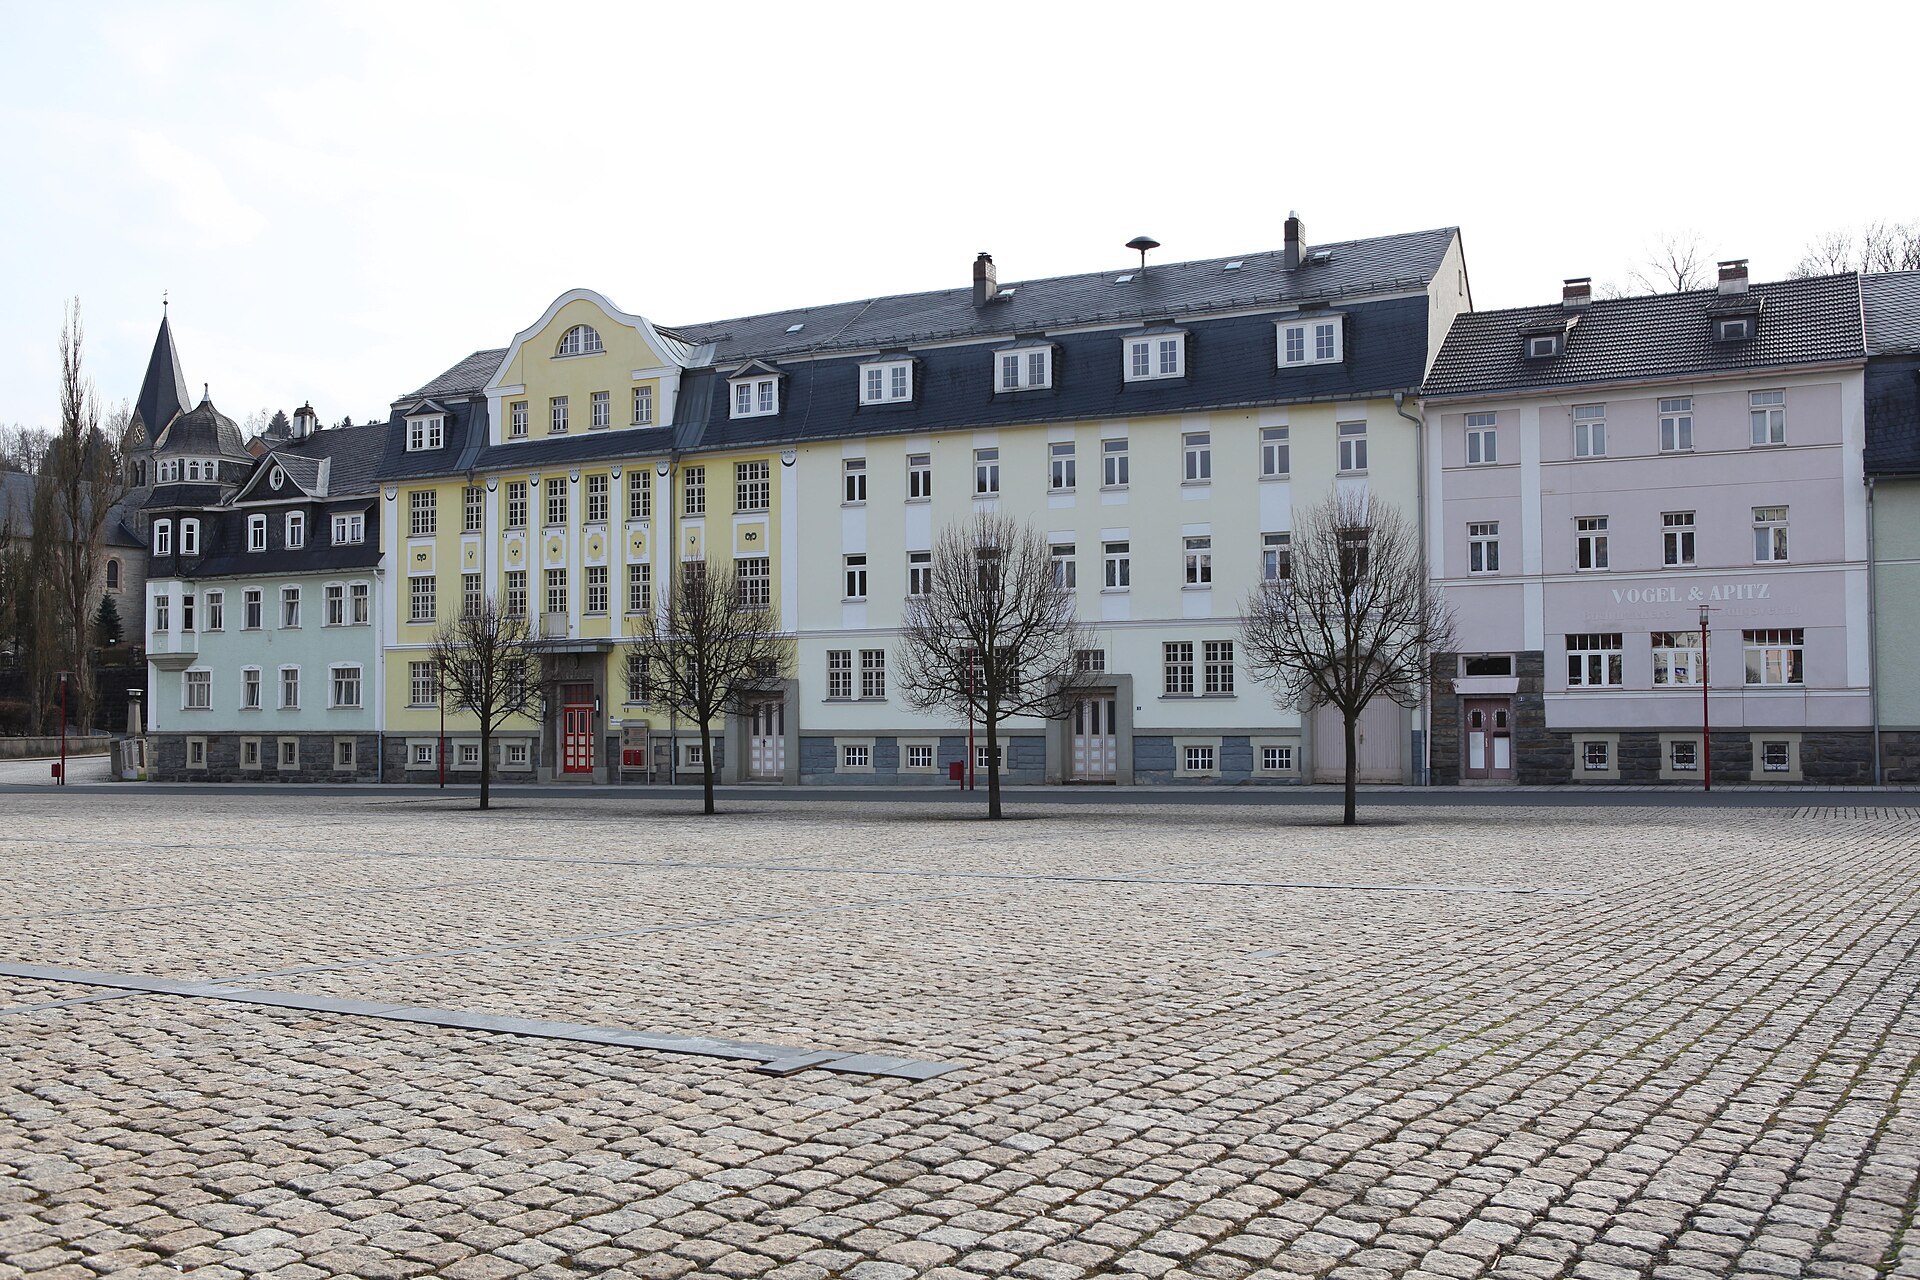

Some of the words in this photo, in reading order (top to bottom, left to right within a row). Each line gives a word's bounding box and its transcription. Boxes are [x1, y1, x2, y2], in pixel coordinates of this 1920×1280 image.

[1611, 586, 1682, 604] VOGEL
[1687, 586, 1704, 601] &
[1709, 583, 1770, 601] APITZ
